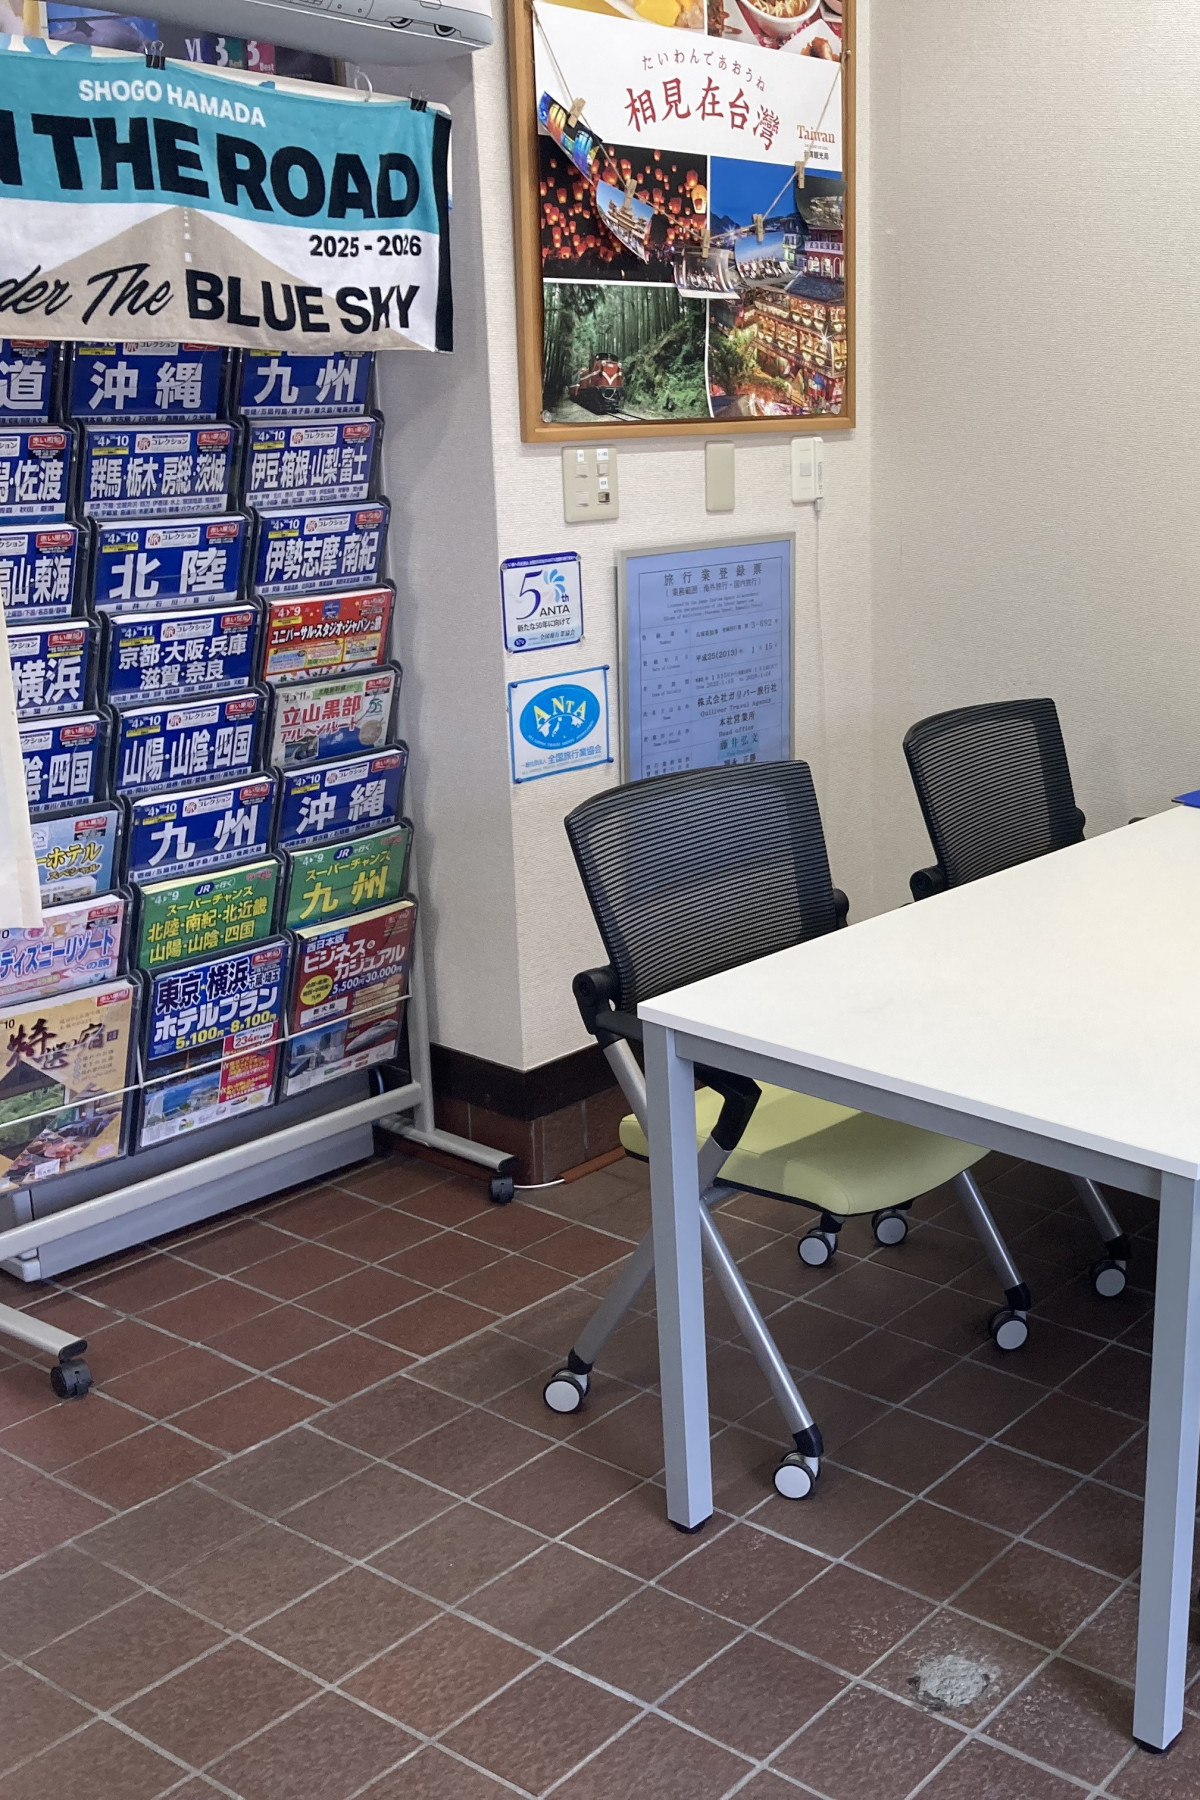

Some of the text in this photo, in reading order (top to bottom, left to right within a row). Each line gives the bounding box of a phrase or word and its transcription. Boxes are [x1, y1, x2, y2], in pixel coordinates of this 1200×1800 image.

[642, 48, 766, 93] たいわんであおうね
[79, 79, 266, 128] SHOGO HAMADA
[624, 76, 780, 151] 相見在台灣
[797, 125, 835, 143] Taiwan
[31, 113, 210, 199] THE
[216, 133, 420, 219] ROAD
[309, 235, 360, 258] 2025
[378, 234, 422, 257] 2026
[79, 263, 174, 325] The
[185, 269, 330, 332] BLUE
[335, 284, 420, 334] SKY
[0, 360, 46, 409] 道
[89, 361, 203, 410] 沖縄
[254, 358, 358, 404] 九州
[109, 547, 227, 599] 北陸
[265, 532, 379, 582] 伊勢志摩・南紀
[664, 562, 763, 587] 旅行業登録票
[540, 604, 571, 617] ANTA
[119, 634, 248, 670] 京都・大阪・兵庫
[139, 659, 224, 690] 滋賀・奈良
[11, 656, 81, 707] 横浜
[697, 683, 777, 708] 株式会社ガリバー旅行社
[280, 695, 362, 728] 立山黒部
[122, 724, 253, 786] 山陽・山陰・四国
[296, 779, 386, 834] 沖縄
[148, 805, 258, 867] 九州
[337, 848, 350, 859] JR
[305, 850, 390, 882] スーパーチャンス
[167, 886, 253, 916] スーパーチャンス
[197, 884, 210, 895] JR
[300, 865, 388, 919] 九州
[149, 920, 255, 963] 山陽・山陰・四国
[304, 939, 365, 973] ビジネス
[333, 944, 406, 981] カジュアル
[156, 957, 250, 1015] 東京・横浜
[154, 987, 278, 1042] ホテルプラン
